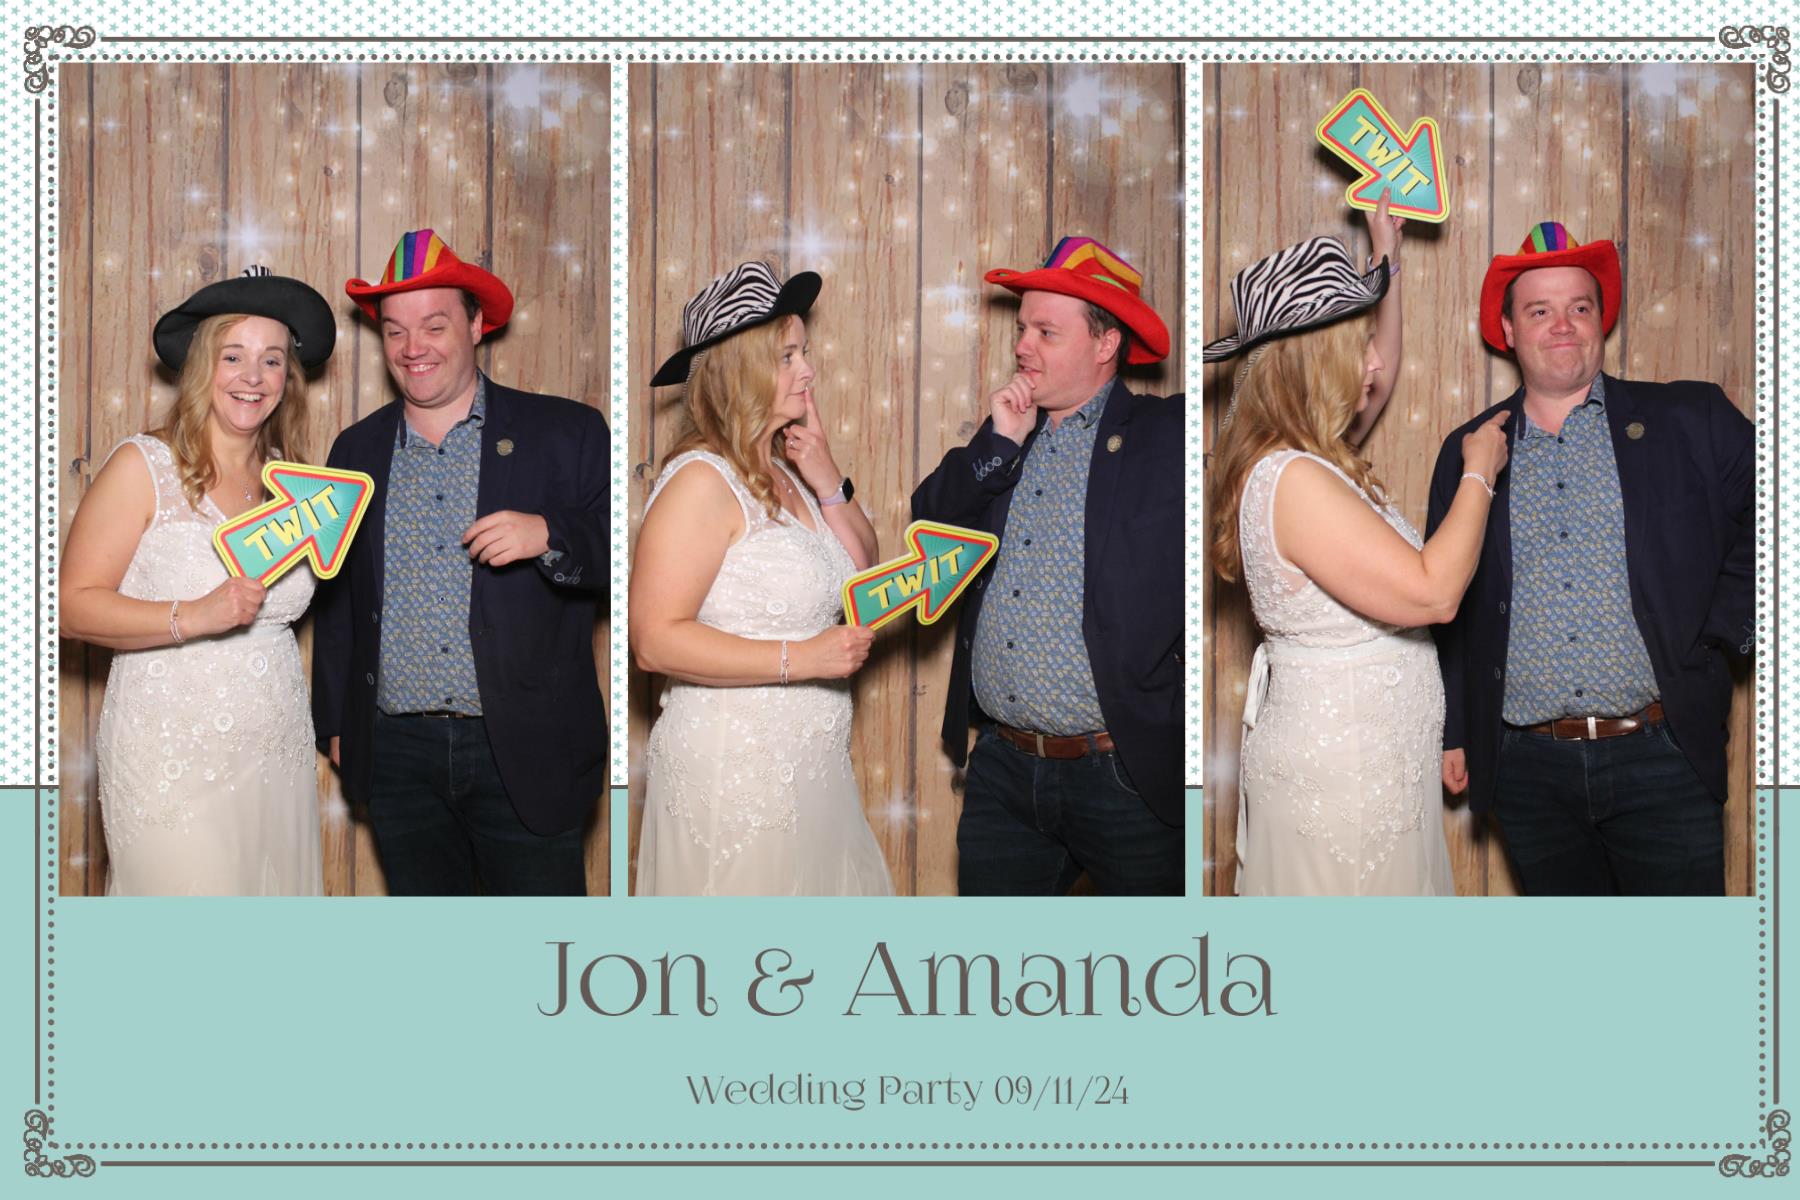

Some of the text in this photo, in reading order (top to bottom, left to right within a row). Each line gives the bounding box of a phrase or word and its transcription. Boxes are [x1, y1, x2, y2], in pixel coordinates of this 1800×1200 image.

[1350, 115, 1432, 196] TWIT
[243, 484, 339, 561] TWIT
[867, 544, 964, 609] TWIT
